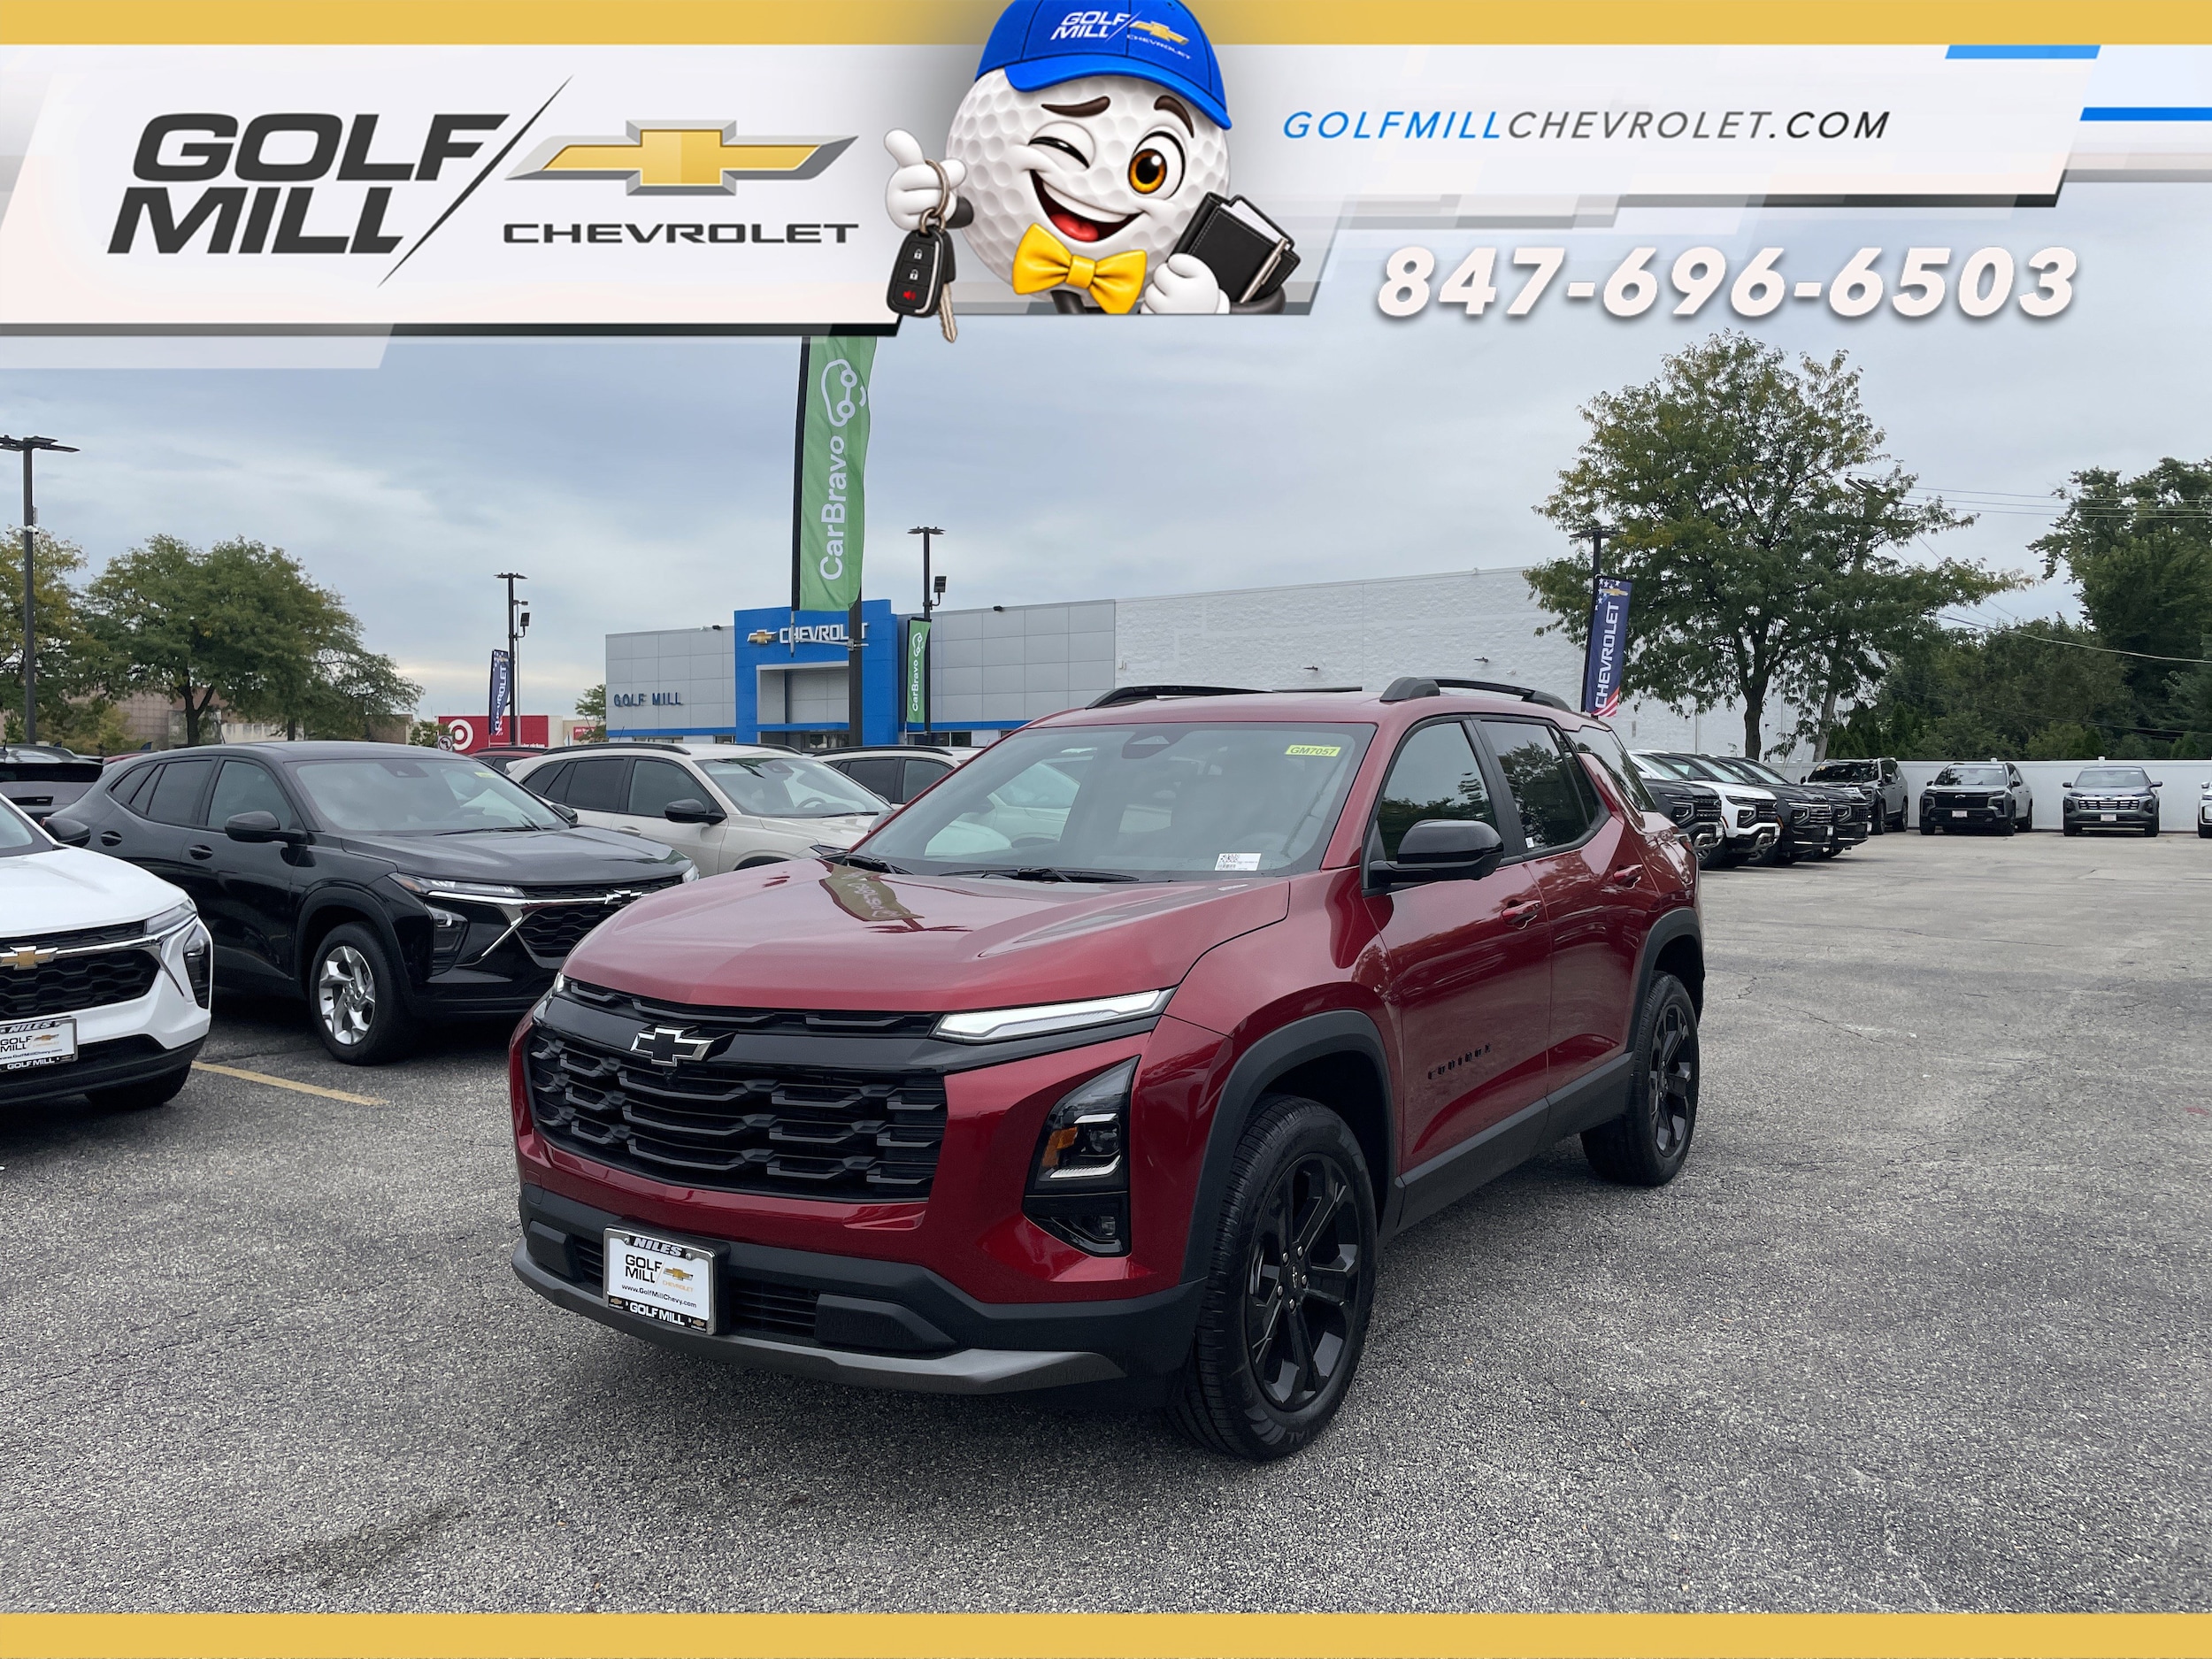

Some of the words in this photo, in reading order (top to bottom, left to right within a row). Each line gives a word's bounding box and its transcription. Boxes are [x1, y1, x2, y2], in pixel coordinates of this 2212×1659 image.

[819, 435, 847, 580] CarBravo
[780, 623, 869, 644] CHEVROLT
[1594, 601, 1619, 709] CHEVROLET
[614, 693, 647, 707] GOLF
[652, 692, 682, 705] MILL
[1290, 747, 1336, 756] GM7057
[8, 1022, 50, 1033] NILES
[0, 1035, 33, 1046] GOLF
[0, 1043, 27, 1053] MILL
[7, 1060, 33, 1070] GOLF
[33, 1056, 55, 1066] MILL
[634, 1237, 682, 1257] NILES
[626, 1254, 663, 1272] GOLF
[625, 1265, 656, 1284] MILL
[621, 1283, 697, 1309] www.GolfMillChevy.com
[629, 1302, 658, 1318] GOLF
[658, 1310, 686, 1326] MILL
